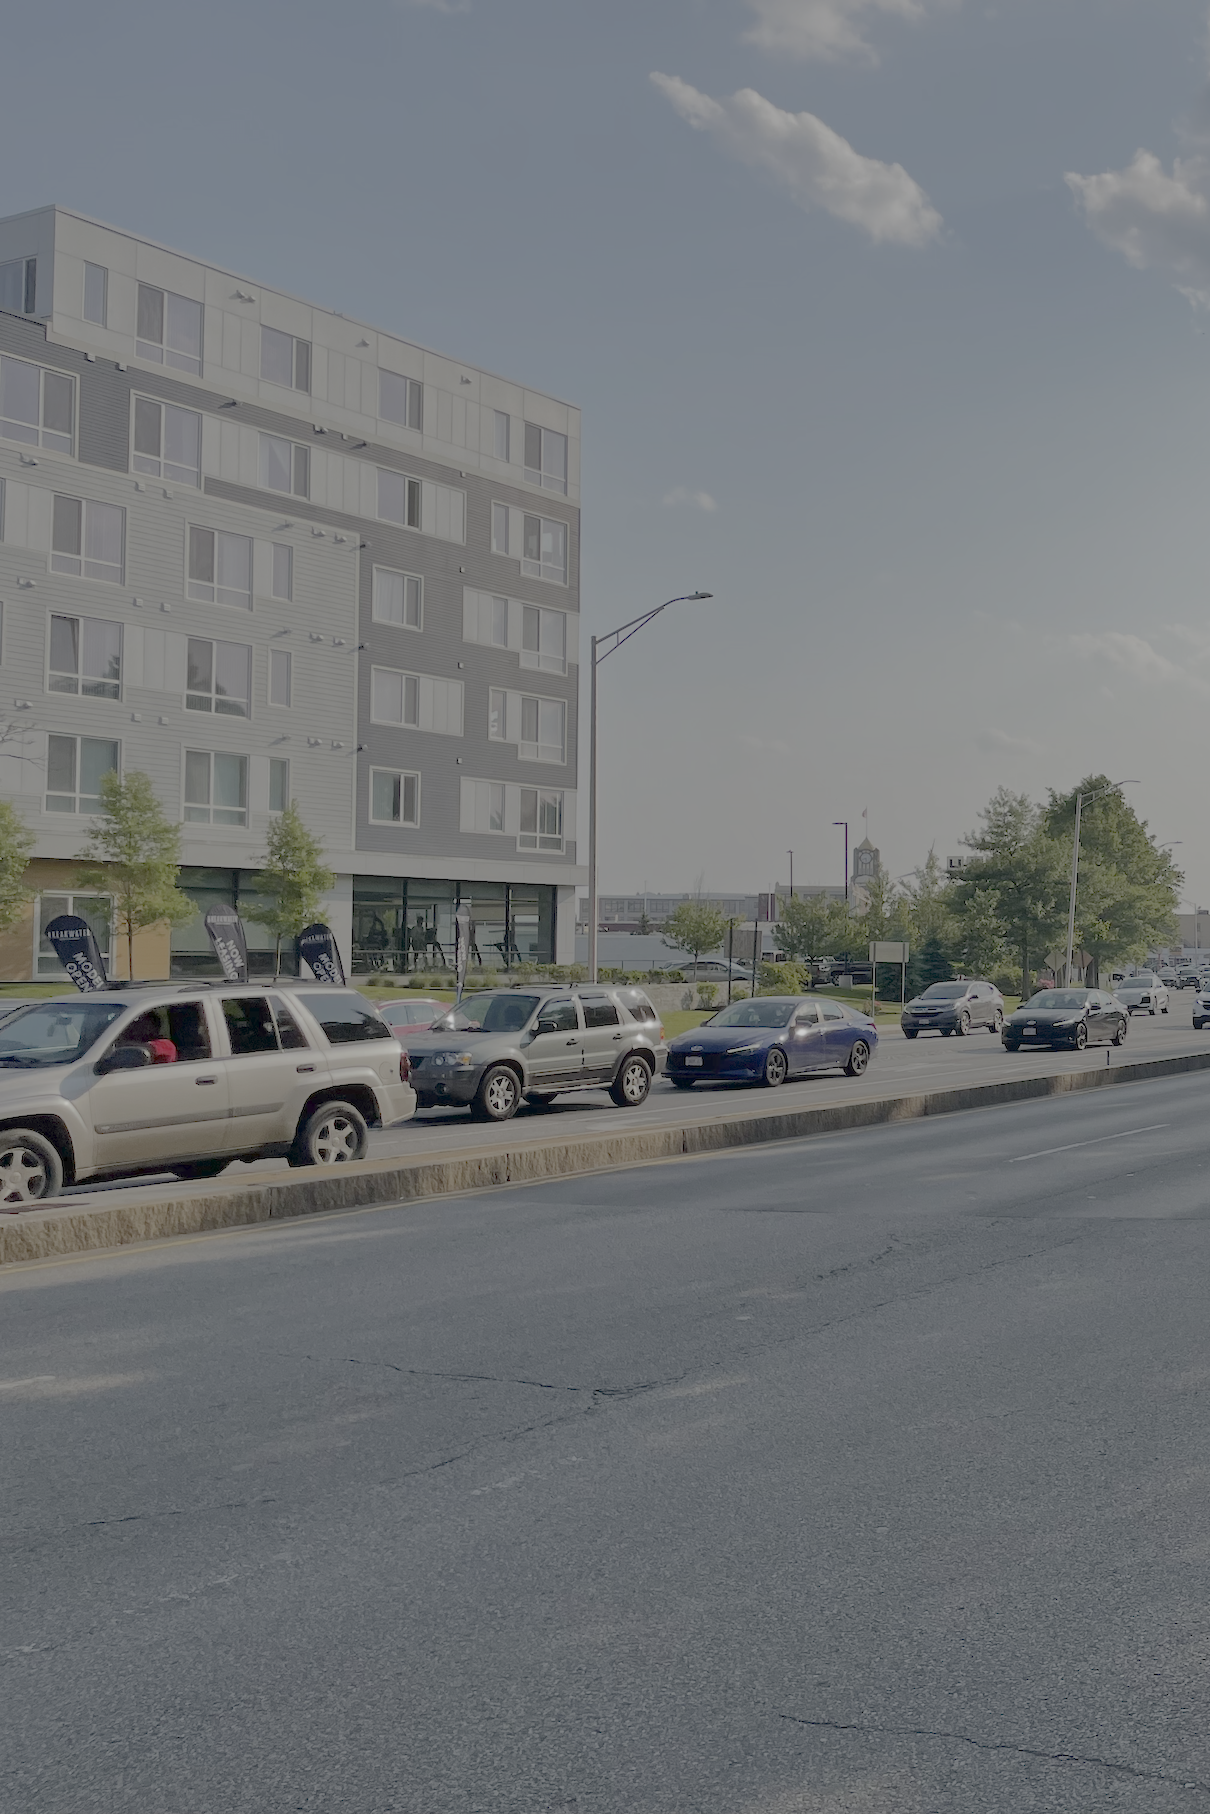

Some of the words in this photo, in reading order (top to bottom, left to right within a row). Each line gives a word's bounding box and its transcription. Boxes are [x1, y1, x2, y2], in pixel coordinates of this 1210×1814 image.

[72, 951, 105, 989] MODEL
[214, 936, 239, 980] LEASING
[226, 939, 245, 968] NOW
[65, 962, 94, 993] OPEN
